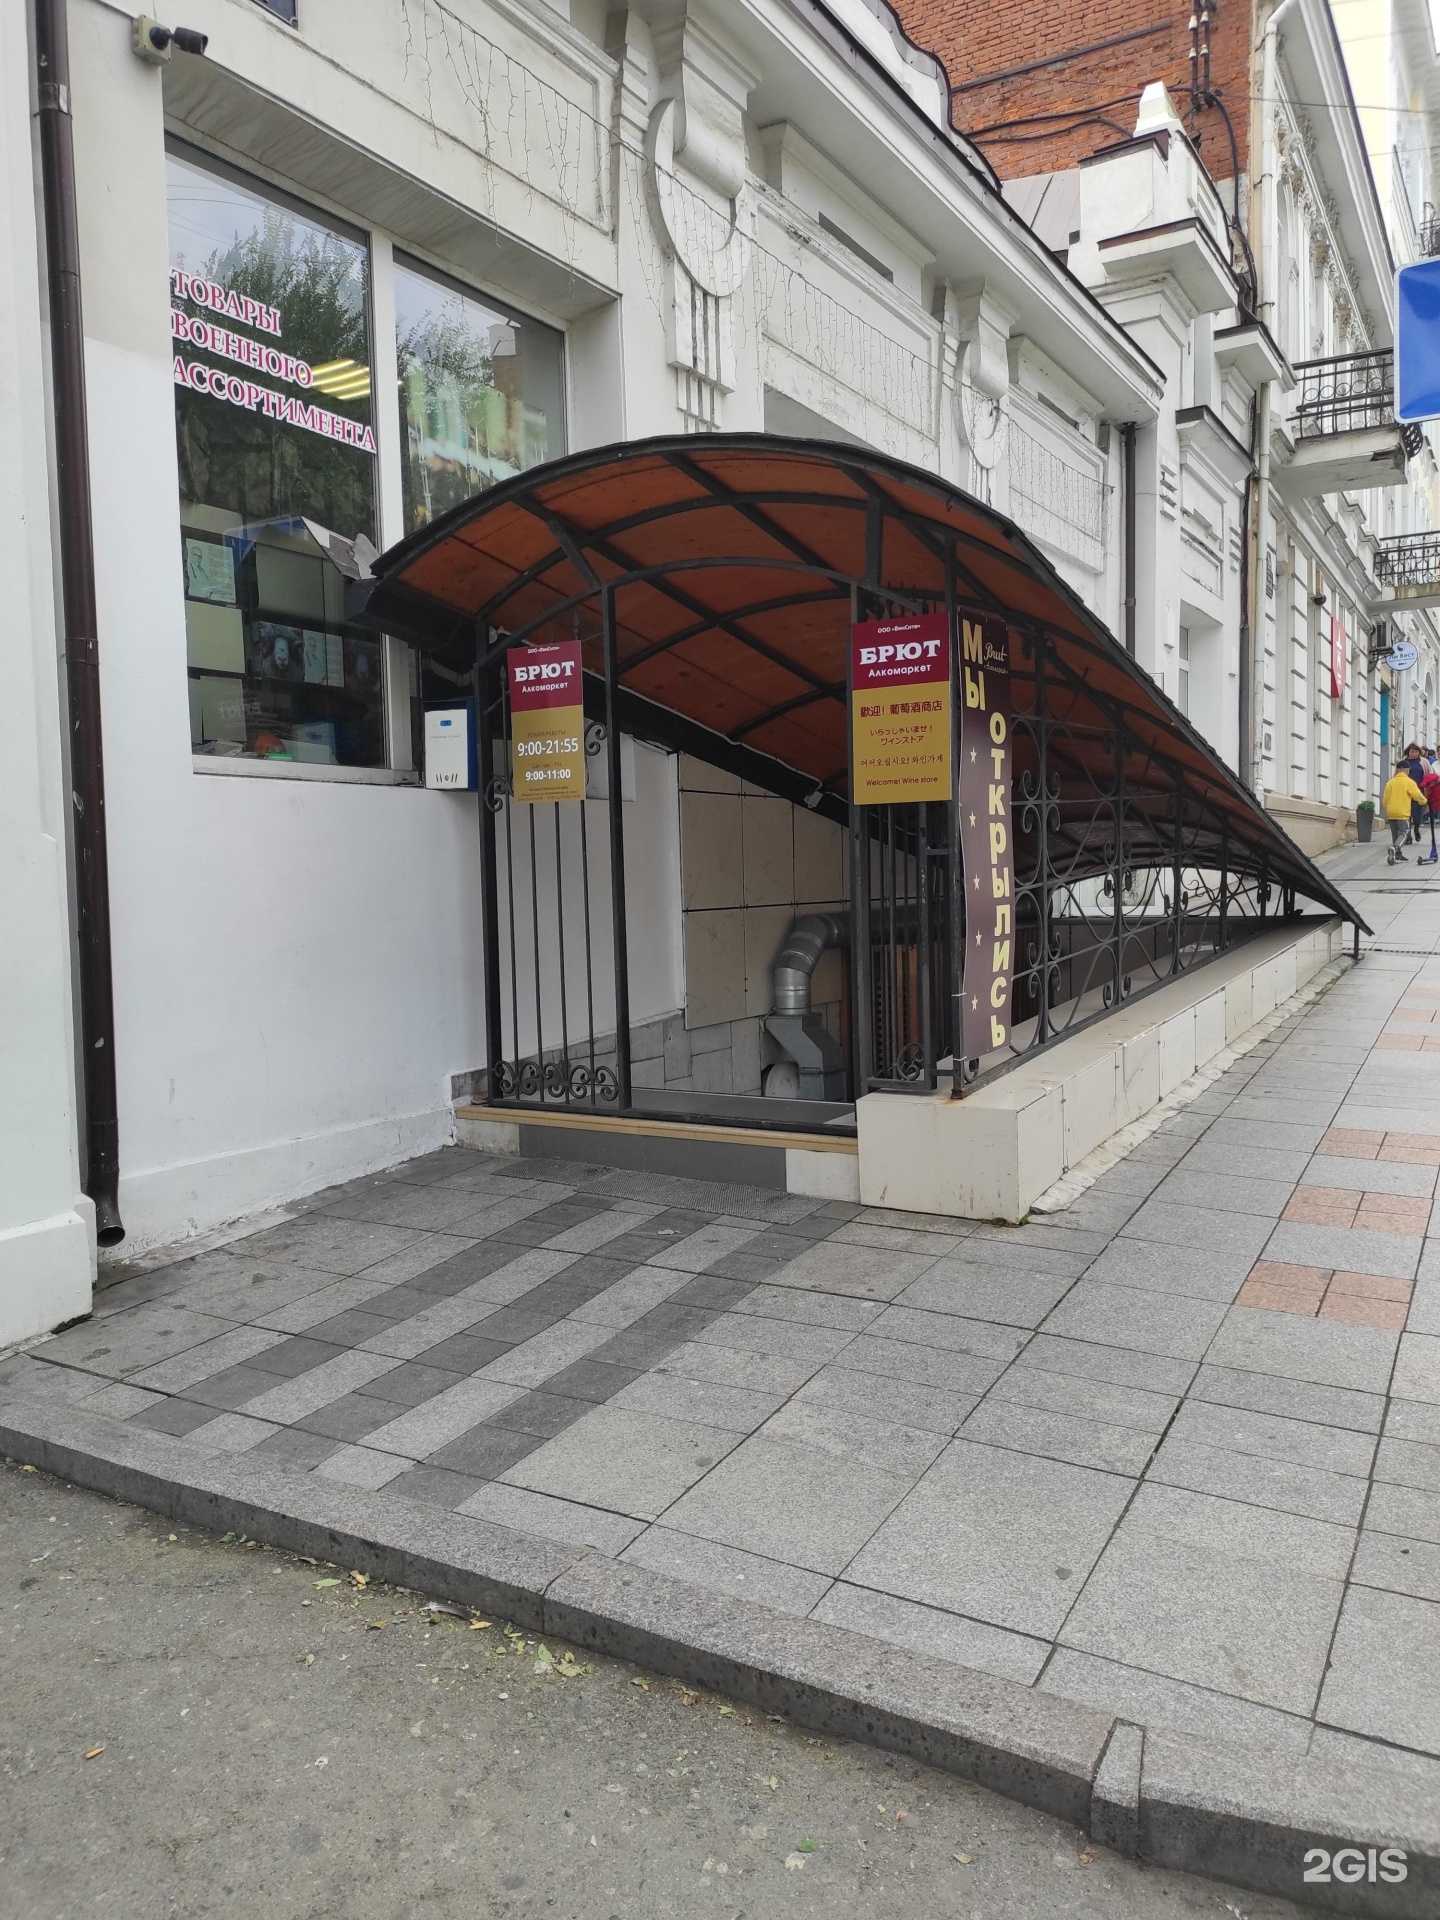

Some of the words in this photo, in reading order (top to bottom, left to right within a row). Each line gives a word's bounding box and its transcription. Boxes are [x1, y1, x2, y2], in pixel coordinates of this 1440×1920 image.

[171, 267, 282, 336] ТОВАРЫ
[171, 308, 314, 388] ВОЕННОГО
[173, 355, 376, 454] АССОРТИМЕНТА
[859, 639, 940, 665] БРЮТ
[514, 660, 575, 682] БРЮТ
[868, 664, 933, 678] Алкомаркет
[522, 682, 569, 694] Алкомаркет
[517, 737, 579, 757] 9:00-21:55
[525, 768, 571, 781] 9:00-11:00
